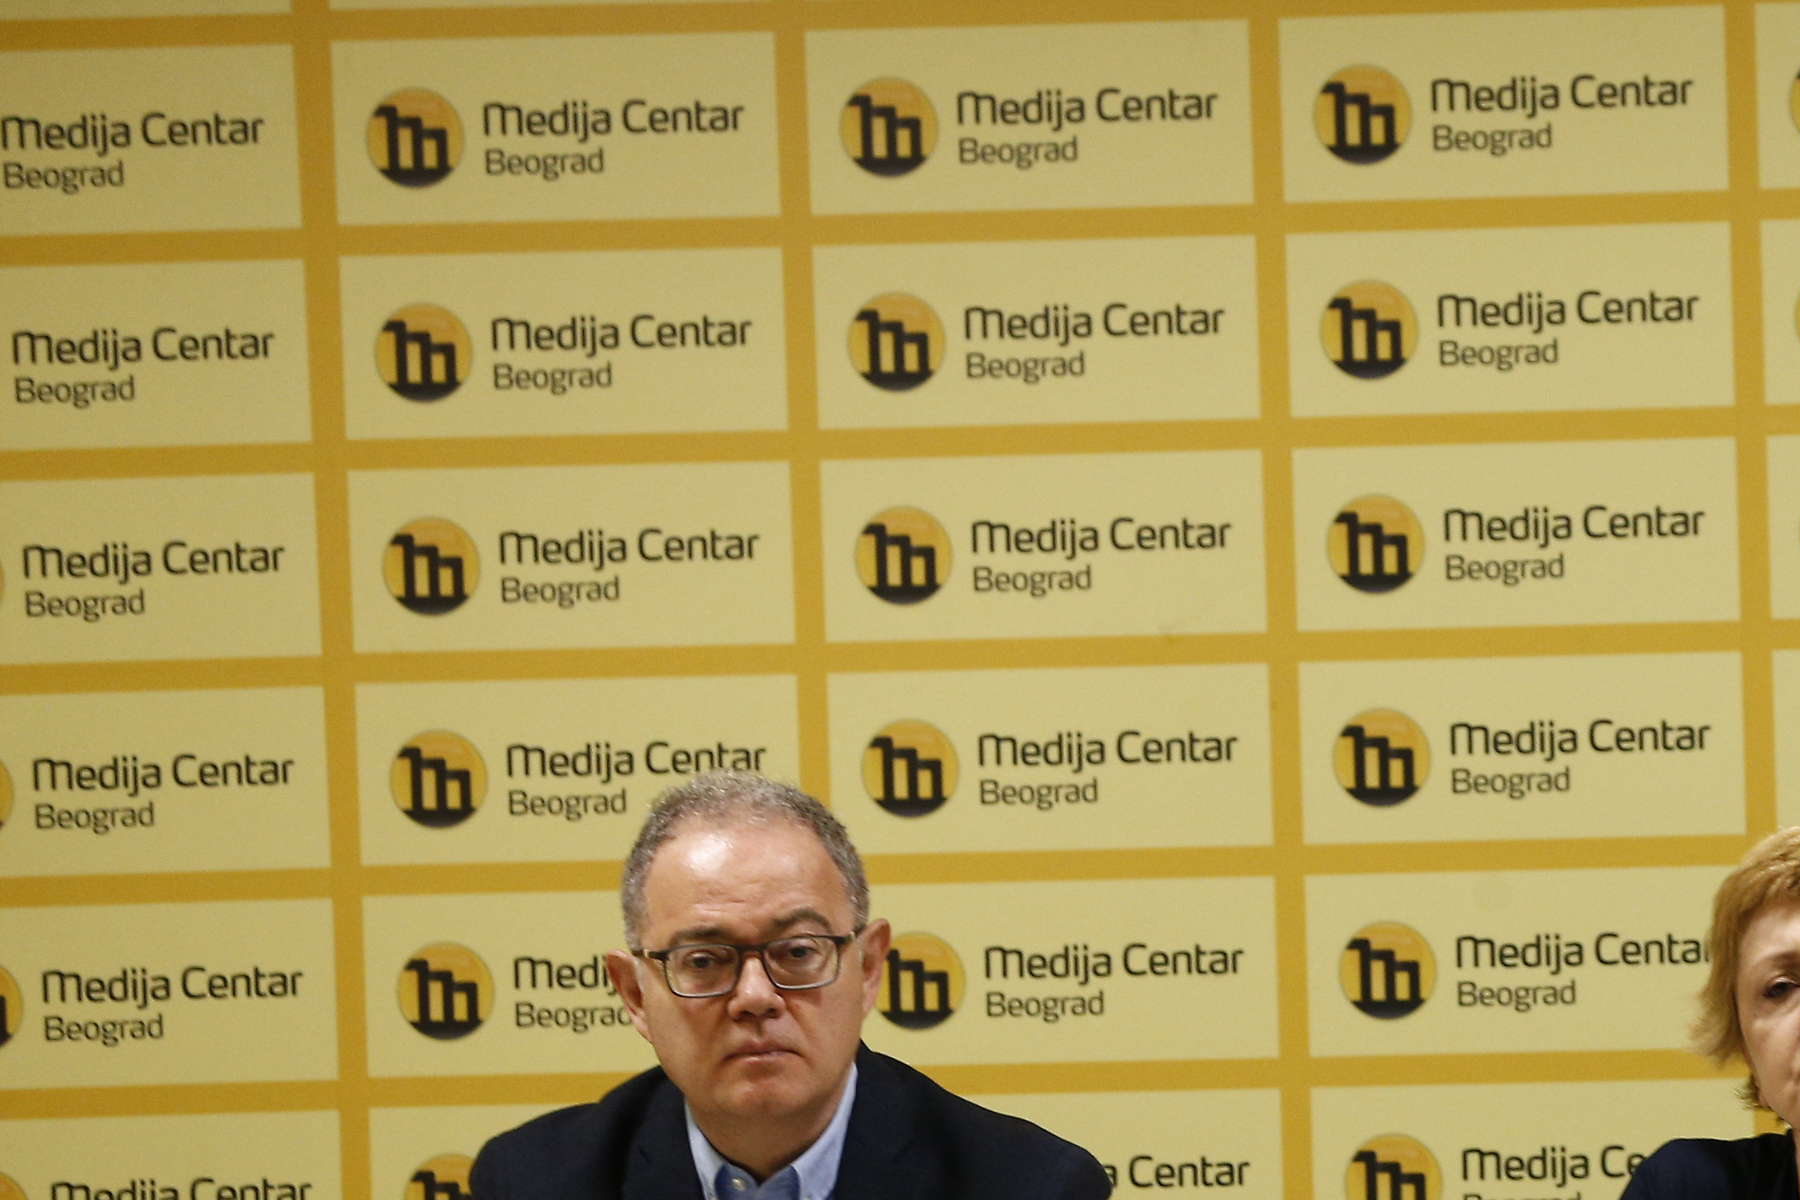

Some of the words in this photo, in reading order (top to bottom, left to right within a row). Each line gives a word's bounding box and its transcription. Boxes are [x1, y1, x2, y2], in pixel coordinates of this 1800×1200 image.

[956, 90, 1086, 132] Medija
[1095, 87, 1218, 123] Centar
[1431, 77, 1560, 119] Medija
[1570, 74, 1693, 109] Centar
[0, 113, 132, 158] Medija
[140, 111, 264, 147] Centar
[483, 101, 612, 144] Medija
[621, 99, 744, 134] Centar
[1432, 123, 1552, 156] Beograd
[485, 148, 604, 181] Beograd
[958, 136, 1078, 169] Beograd
[3, 160, 124, 195] Beograd
[964, 305, 1093, 347] Medija
[1102, 302, 1225, 337] Centar
[1437, 292, 1566, 335] Medija
[1576, 290, 1699, 325] Centar
[11, 328, 142, 372] Medija
[151, 326, 274, 362] Centar
[491, 315, 620, 358] Medija
[630, 314, 752, 349] Centar
[1439, 338, 1558, 371] Beograd
[493, 362, 612, 395] Beograd
[966, 351, 1085, 384] Beograd
[14, 374, 135, 409] Beograd
[971, 519, 1100, 561] Medija
[1109, 517, 1231, 551] Centar
[1443, 507, 1573, 549] Medija
[1582, 505, 1705, 539] Centar
[22, 542, 152, 586] Medija
[161, 540, 285, 576] Centar
[498, 530, 628, 572] Medija
[637, 528, 759, 562] Centar
[1445, 553, 1564, 586] Beograd
[501, 576, 620, 608] Beograd
[973, 565, 1091, 597] Beograd
[25, 589, 145, 623] Beograd
[978, 732, 1106, 774] Medija
[1116, 730, 1238, 765] Centar
[1450, 721, 1578, 763] Medija
[1588, 718, 1711, 753] Centar
[32, 755, 162, 798] Medija
[171, 753, 295, 788] Centar
[506, 742, 635, 784] Medija
[645, 741, 767, 774] Centar
[1451, 766, 1570, 800] Beograd
[508, 788, 627, 821] Beograd
[979, 778, 1098, 811] Beograd
[34, 801, 155, 835] Beograd
[513, 955, 618, 996] Medi
[984, 944, 1113, 987] Medija
[1122, 942, 1244, 977] Centar
[1456, 934, 1584, 976] Medija
[41, 967, 171, 1010] Medija
[180, 965, 304, 1000] Centar
[986, 990, 1105, 1023] Beograd
[1457, 979, 1576, 1013] Beograd
[44, 1013, 164, 1047] Beograd
[1128, 1155, 1251, 1188] Centar
[1461, 1146, 1590, 1189] Medija
